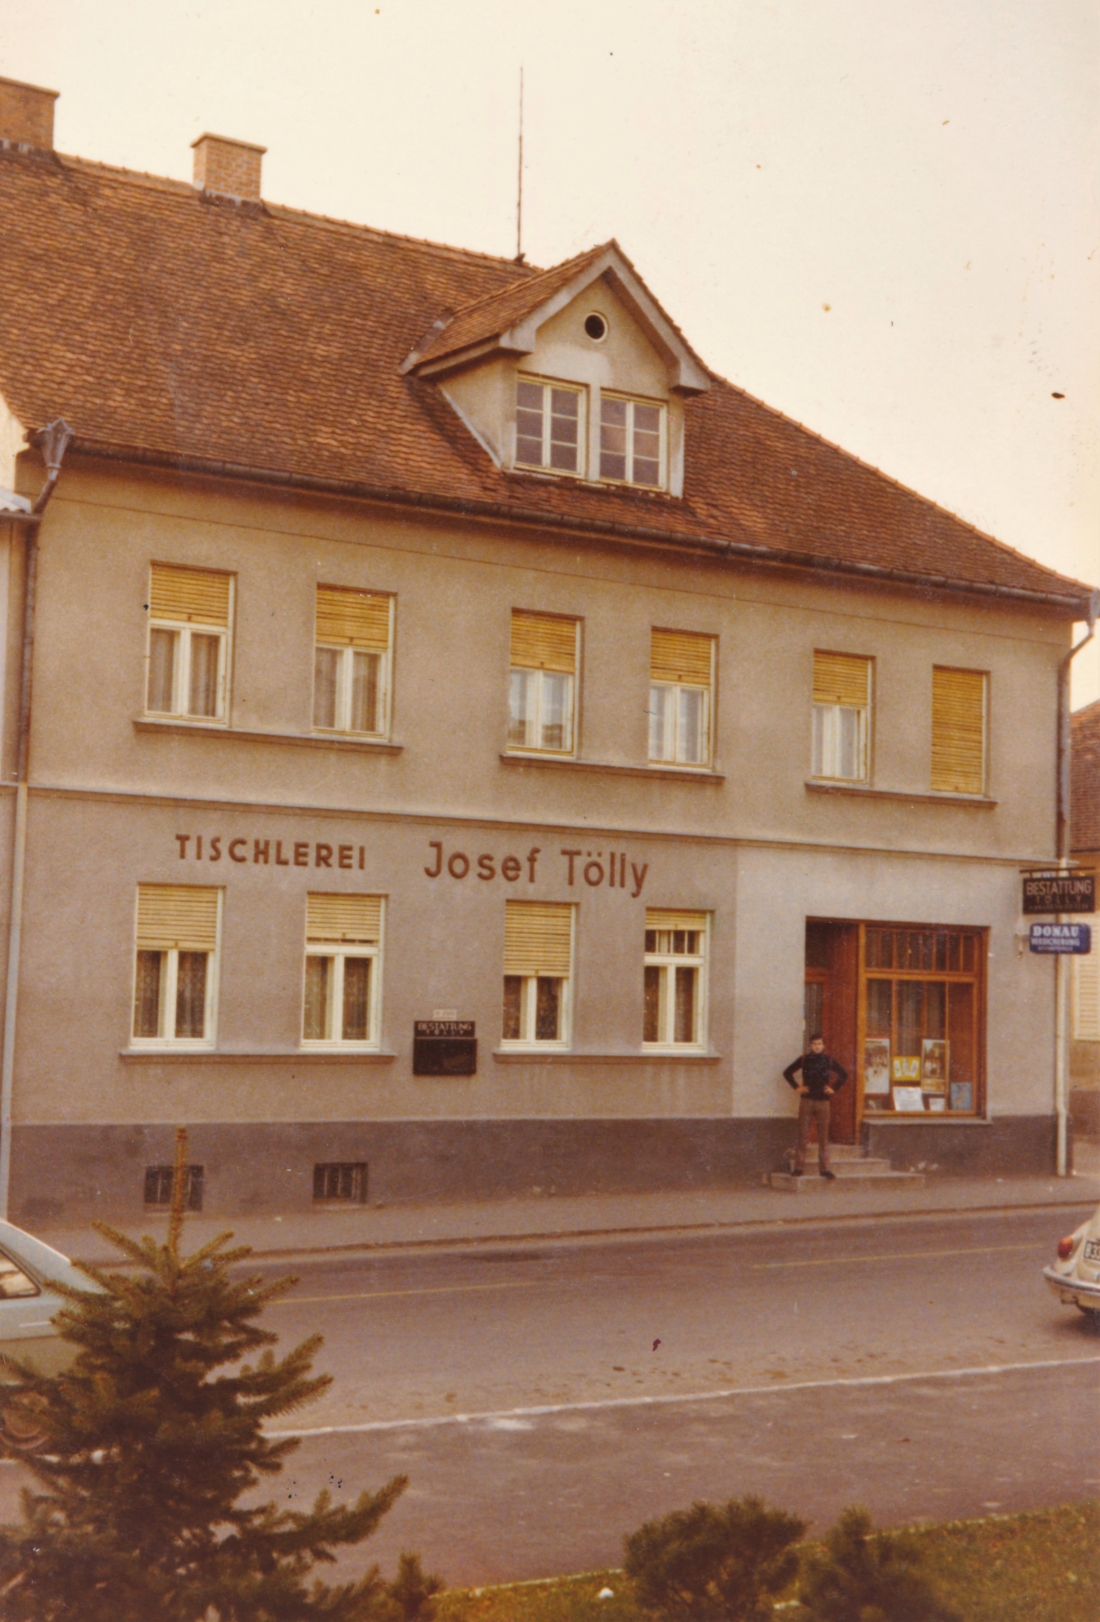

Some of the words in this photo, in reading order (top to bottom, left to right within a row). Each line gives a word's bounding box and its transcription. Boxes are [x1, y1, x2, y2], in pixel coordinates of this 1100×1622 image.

[175, 834, 366, 870] TISCHLEREI
[424, 840, 541, 883] Josef
[560, 848, 649, 898] Tölly
[1026, 879, 1092, 896] BESTATTUNG
[1033, 925, 1079, 938] DONAU
[417, 1022, 472, 1031] BESTATTUNG
